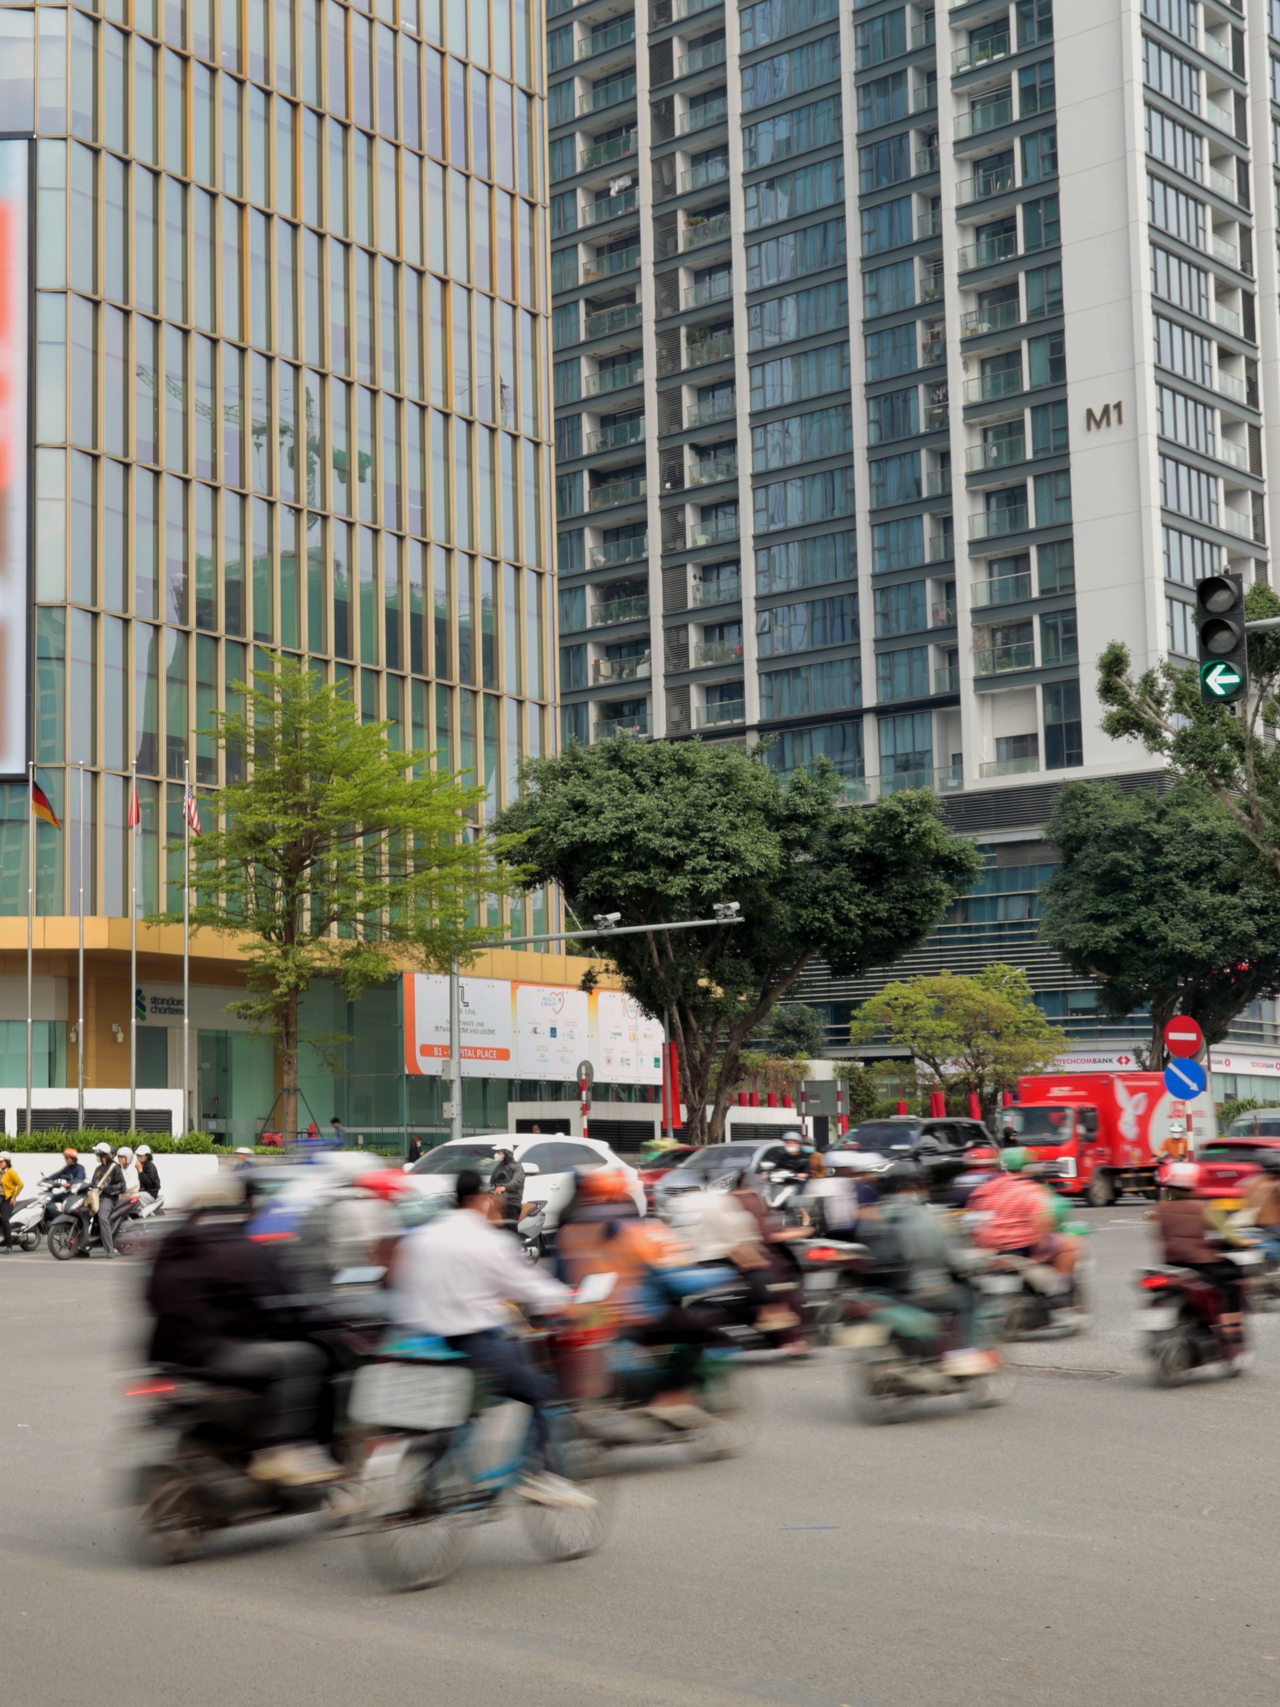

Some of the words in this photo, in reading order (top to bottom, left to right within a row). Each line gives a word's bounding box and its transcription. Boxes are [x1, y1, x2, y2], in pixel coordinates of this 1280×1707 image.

[1086, 400, 1123, 431] M1
[150, 1005, 185, 1015] chartere
[433, 1047, 442, 1056] B1
[477, 1049, 497, 1059] PLACE
[1059, 1057, 1114, 1065] TECHCOMBANK
